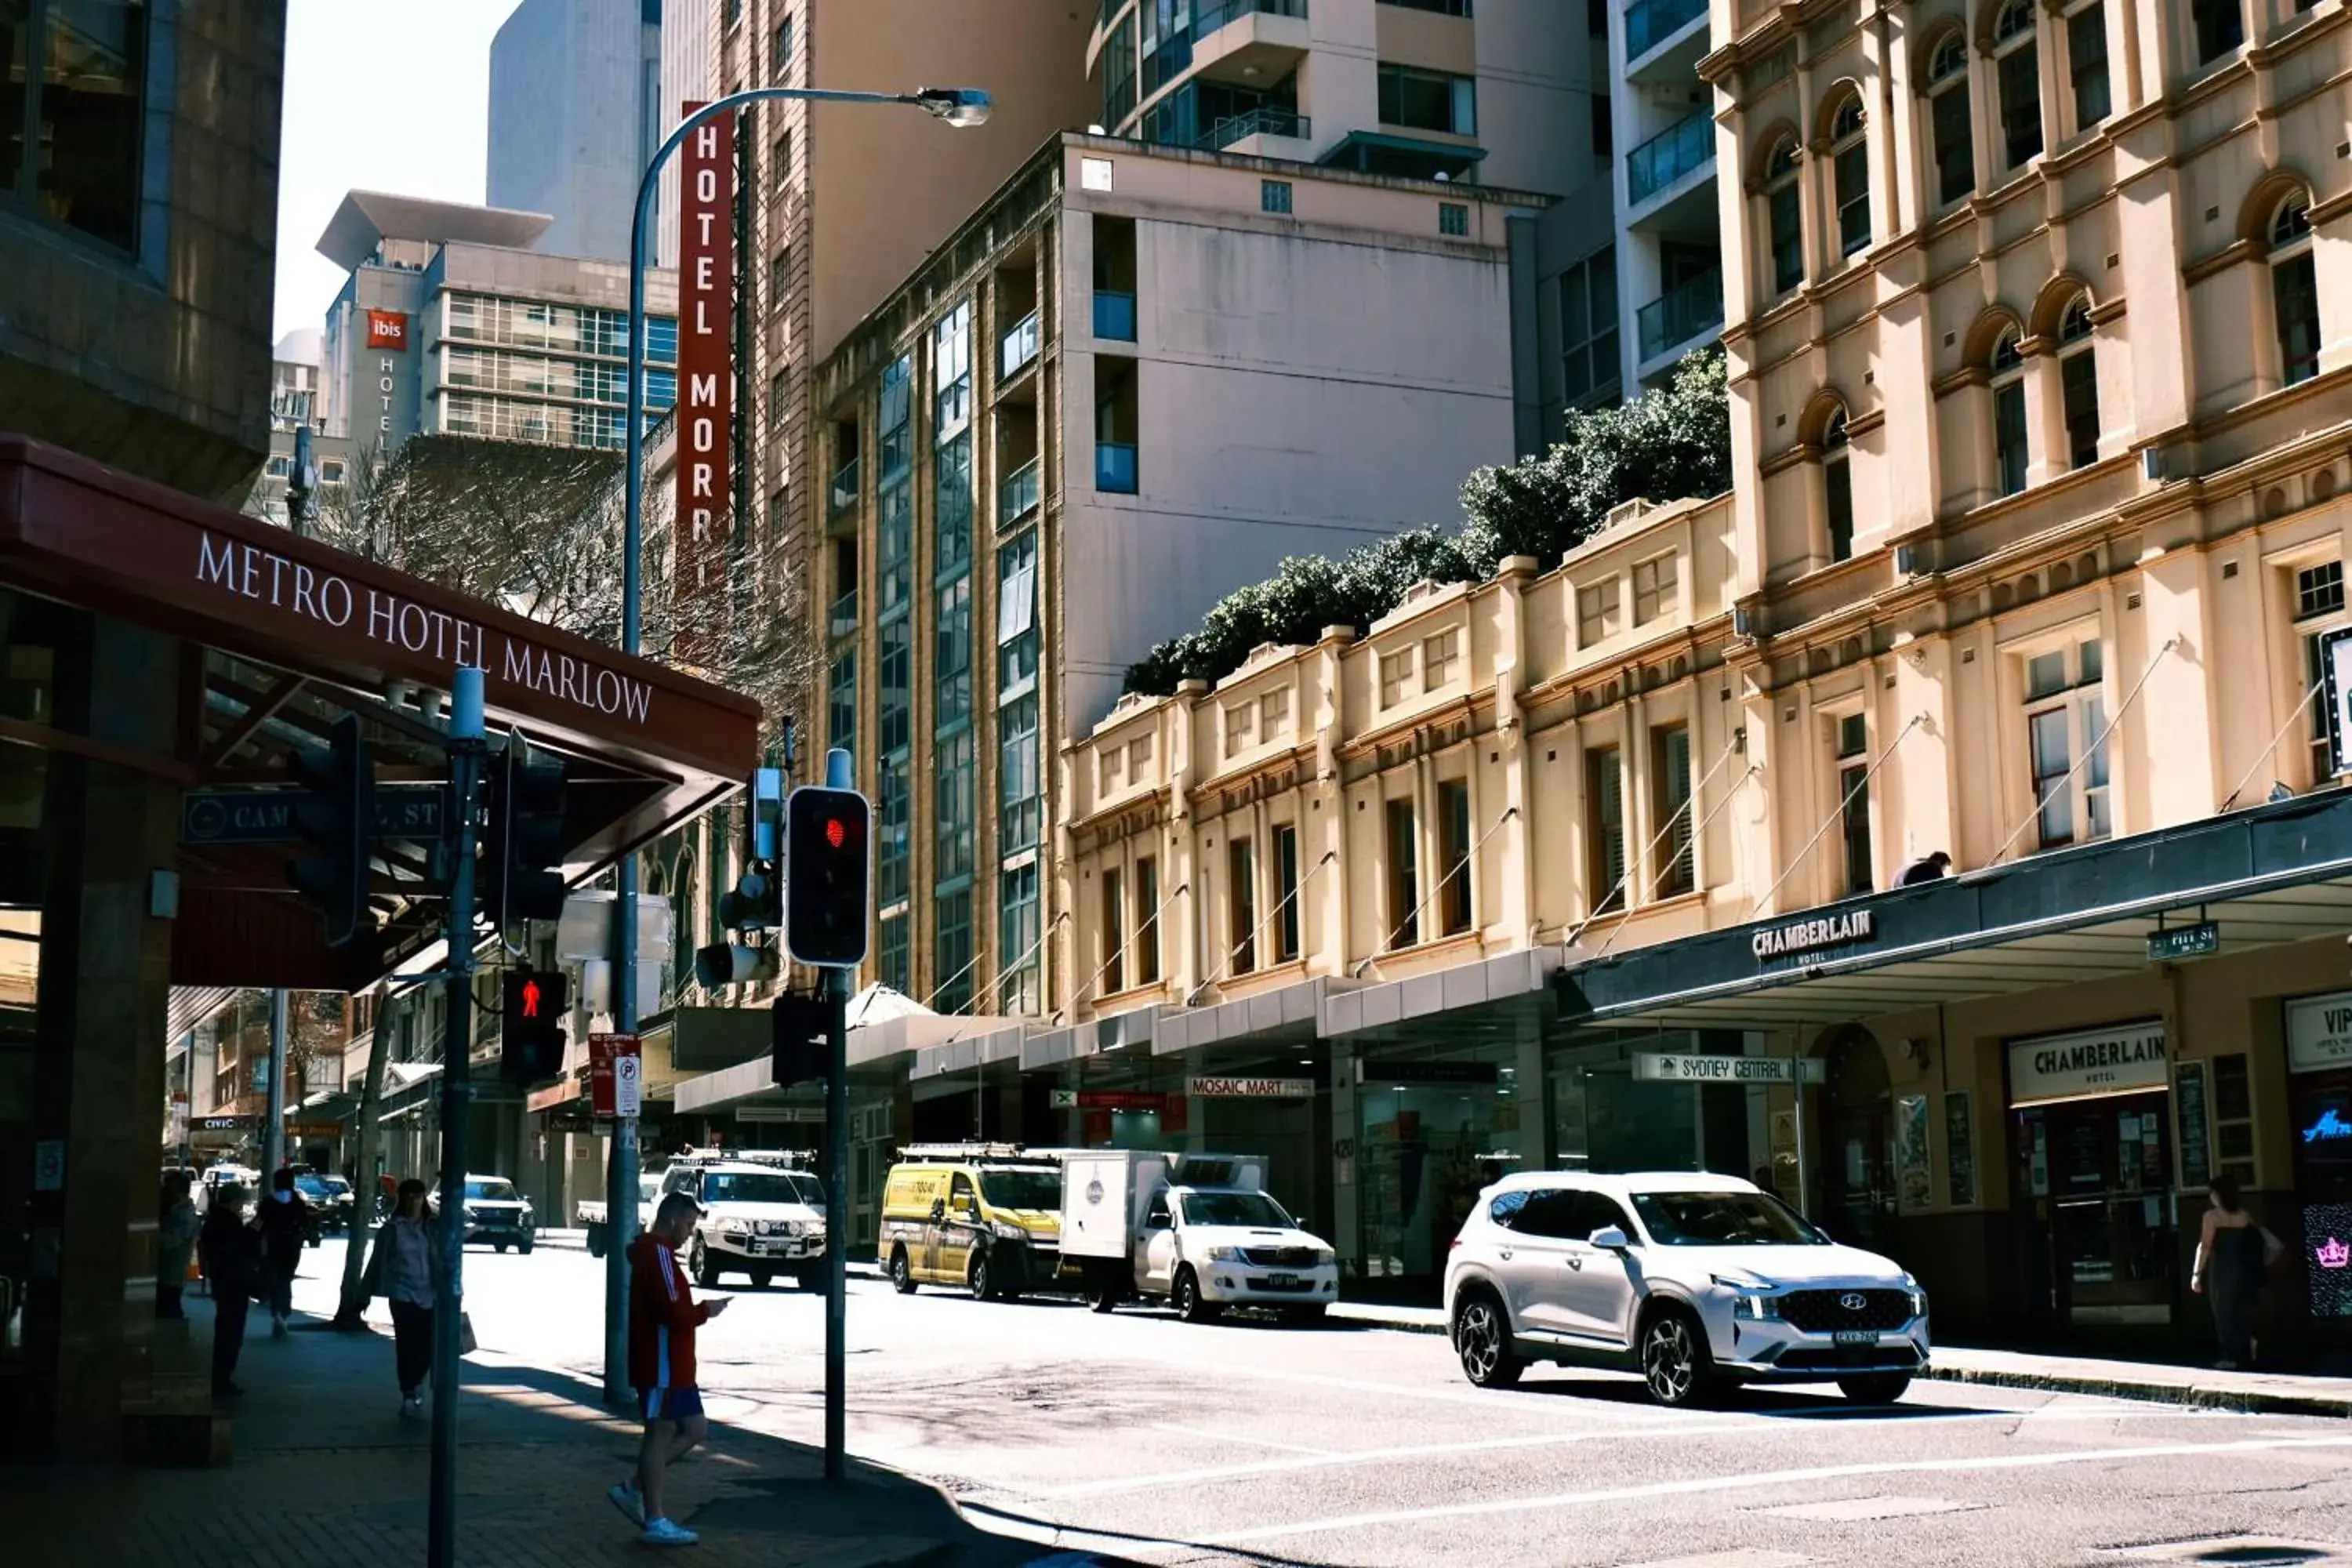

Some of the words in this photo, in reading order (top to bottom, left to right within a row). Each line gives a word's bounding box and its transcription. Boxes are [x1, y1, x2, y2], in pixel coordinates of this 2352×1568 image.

[697, 126, 717, 335] HOTEL
[374, 319, 401, 337] ibis
[379, 358, 393, 451] HOTEL
[691, 373, 716, 633] MORRI
[195, 531, 352, 626] METRO
[367, 590, 491, 673] HOTEL
[503, 639, 653, 724] MARLOW
[405, 803, 438, 826] ST
[1752, 909, 1872, 956] CHAMBERLAIN
[1798, 953, 1826, 965] HOTEL
[2324, 1007, 2352, 1035] VIP
[2034, 1036, 2165, 1075] CHAMBERLAIN
[1192, 1079, 1243, 1095] MOSAIC
[1246, 1080, 1282, 1094] MART
[2085, 1072, 2116, 1083] HOTEL
[205, 1119, 236, 1129] CIVIC
